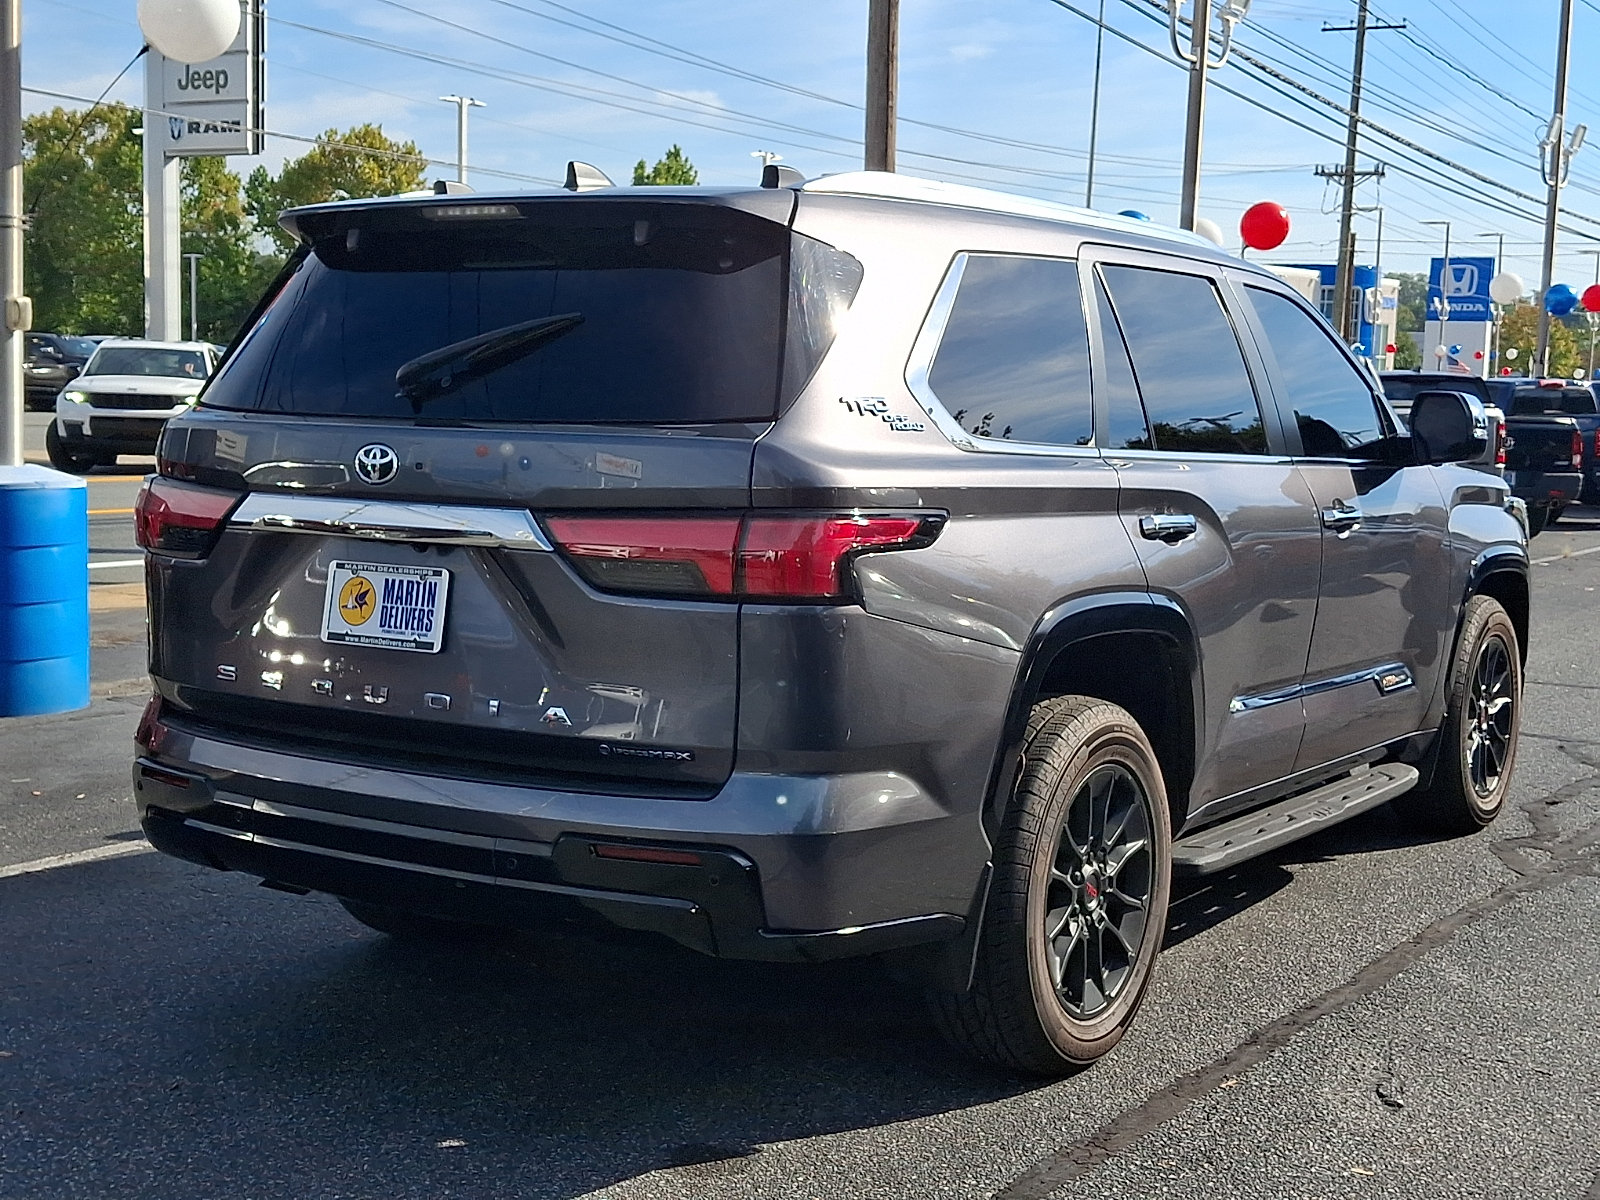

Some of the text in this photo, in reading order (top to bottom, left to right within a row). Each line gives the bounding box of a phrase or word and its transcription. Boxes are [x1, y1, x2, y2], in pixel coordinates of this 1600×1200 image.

[177, 64, 229, 95] Jeep
[187, 120, 241, 134] RAM
[1429, 302, 1486, 311] HNDA
[344, 563, 434, 576] MARTIN DEALERSHIPS
[382, 578, 438, 609] MARTIN
[379, 605, 434, 632] DELIVERS
